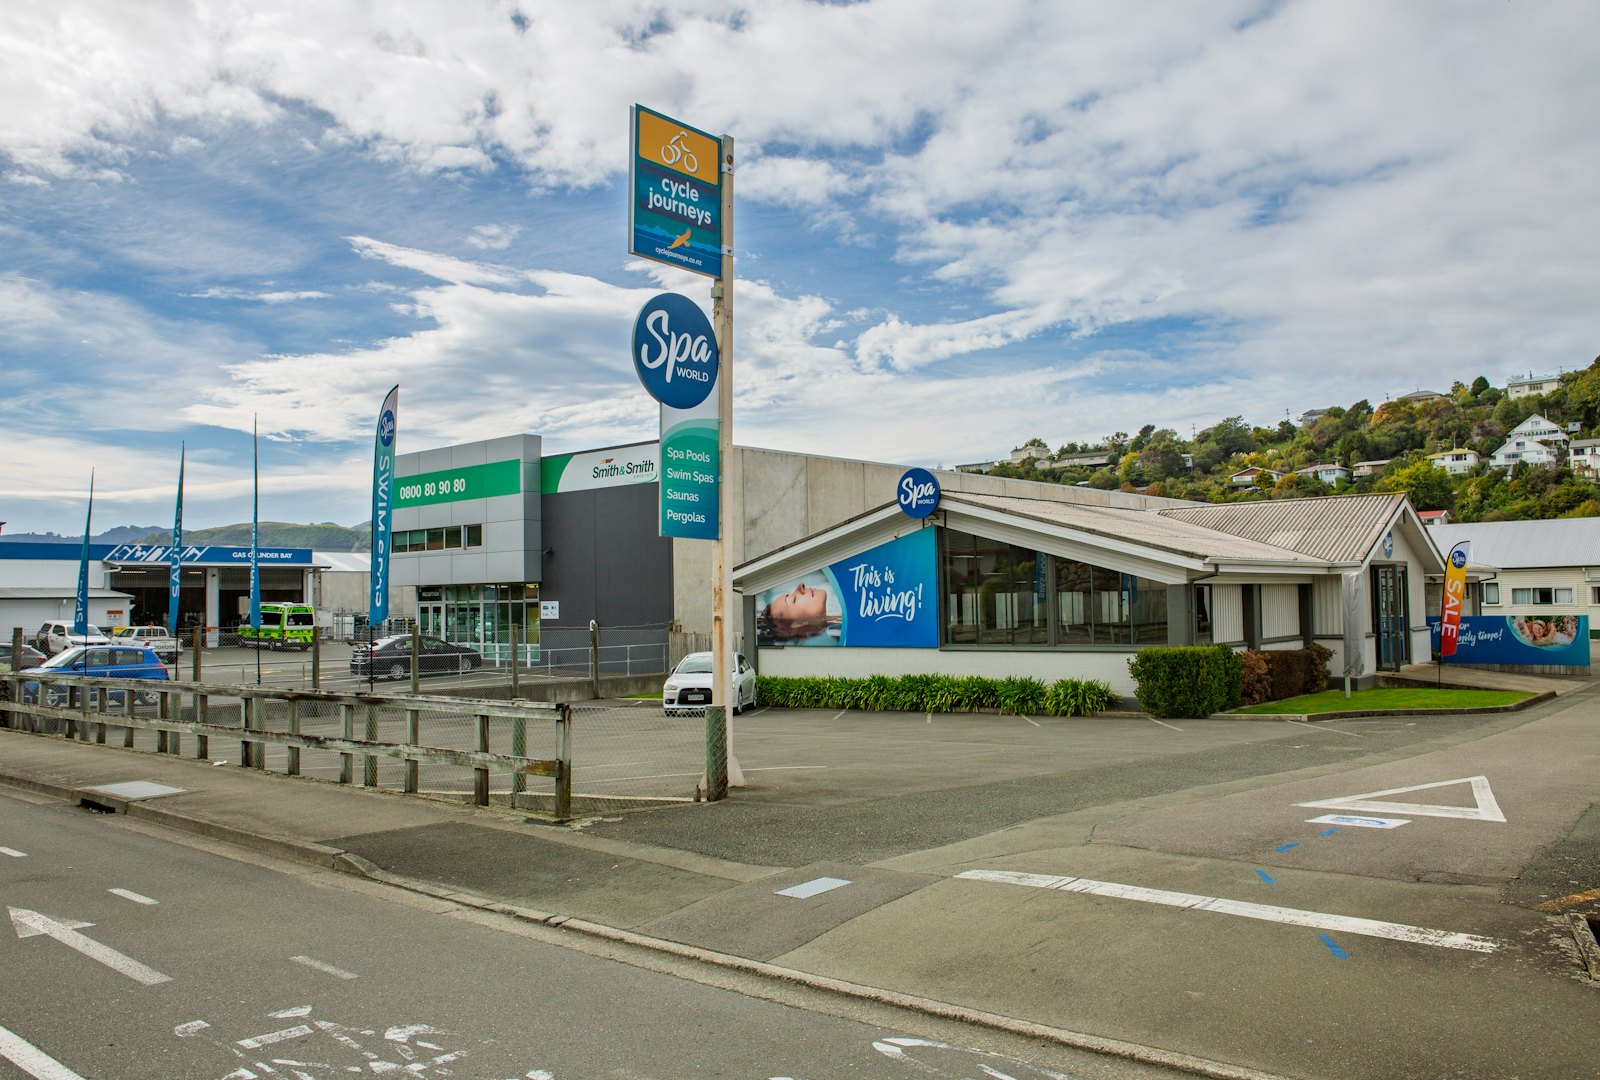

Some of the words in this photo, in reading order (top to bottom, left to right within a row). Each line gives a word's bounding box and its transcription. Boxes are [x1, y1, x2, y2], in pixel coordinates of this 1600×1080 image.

[662, 178, 699, 201] cycle
[648, 187, 712, 226] journeys
[655, 247, 702, 266] cyclejourneys.co.nz
[641, 309, 712, 383] Spa
[676, 366, 709, 382] WORLD
[667, 446, 684, 460] Spa
[686, 449, 711, 463] Pools
[666, 467, 691, 480] Swim
[693, 471, 714, 485] Spas
[378, 455, 390, 532] SWIM
[399, 484, 422, 500] 0800
[424, 482, 436, 497] 80
[438, 480, 450, 495] 90
[453, 478, 466, 493] 80
[666, 488, 699, 502] Saunas
[900, 476, 936, 509] Spa
[666, 509, 706, 525] Pergolas
[848, 563, 882, 592] This
[884, 566, 895, 584] is
[1441, 578, 1462, 638] SALE
[1477, 628, 1503, 642] time!
